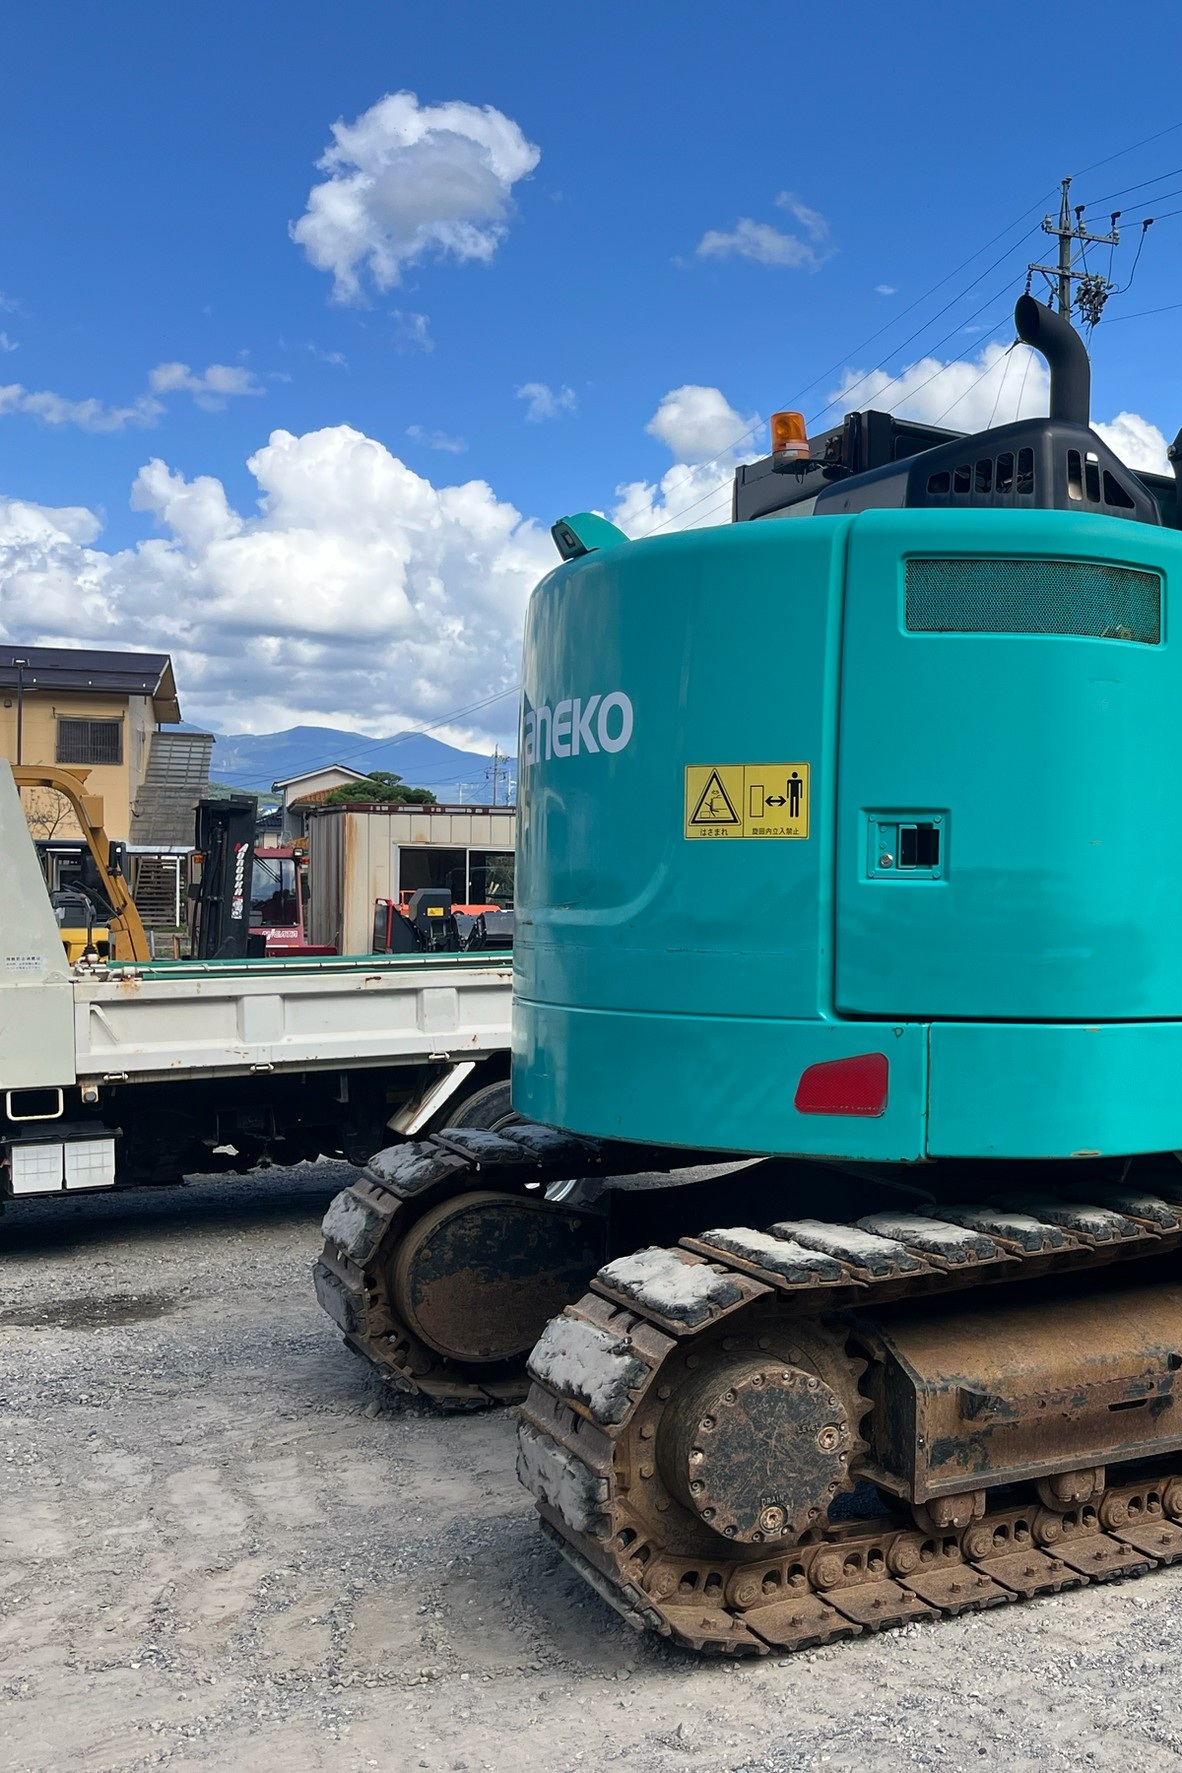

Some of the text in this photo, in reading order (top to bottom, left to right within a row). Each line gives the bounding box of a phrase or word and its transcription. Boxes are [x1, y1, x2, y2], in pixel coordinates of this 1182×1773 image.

[700, 828, 729, 836] はさまれ
[761, 1494, 787, 1507] DRAIN
